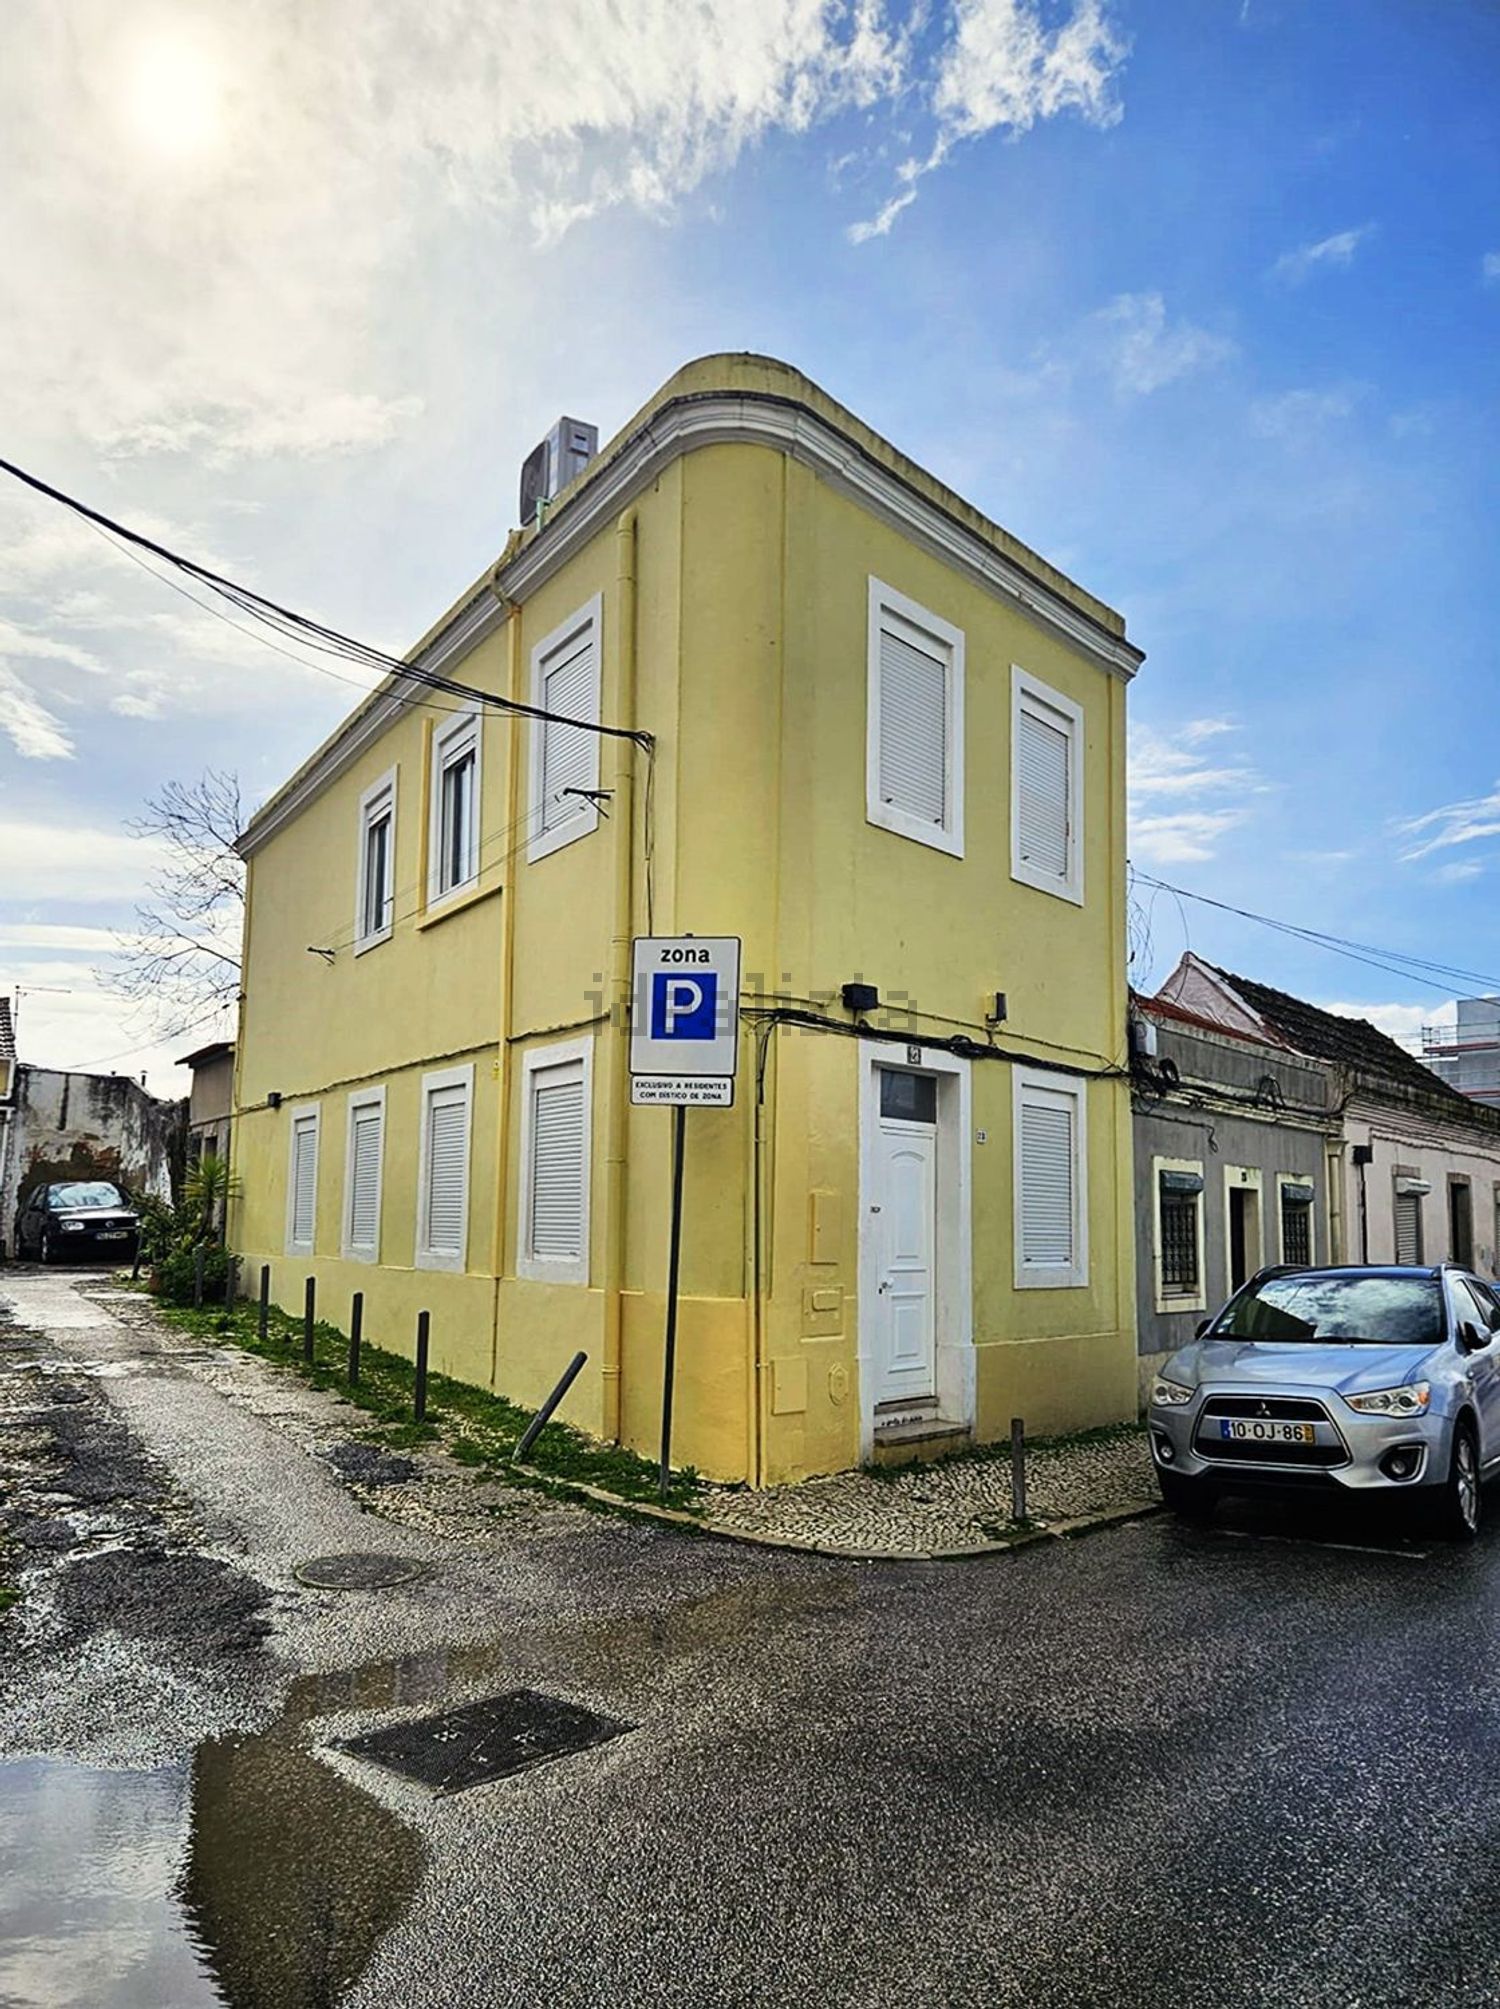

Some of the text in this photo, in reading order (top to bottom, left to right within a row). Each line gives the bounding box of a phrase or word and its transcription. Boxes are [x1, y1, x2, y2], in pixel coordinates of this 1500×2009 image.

[660, 948, 711, 964] zona
[665, 979, 703, 1035] P
[635, 1081, 728, 1091] EXCLUSIVO A RESIDENTES
[639, 1091, 657, 1100] COM
[689, 1092, 700, 1101] DE
[702, 1092, 723, 1101] ZONA
